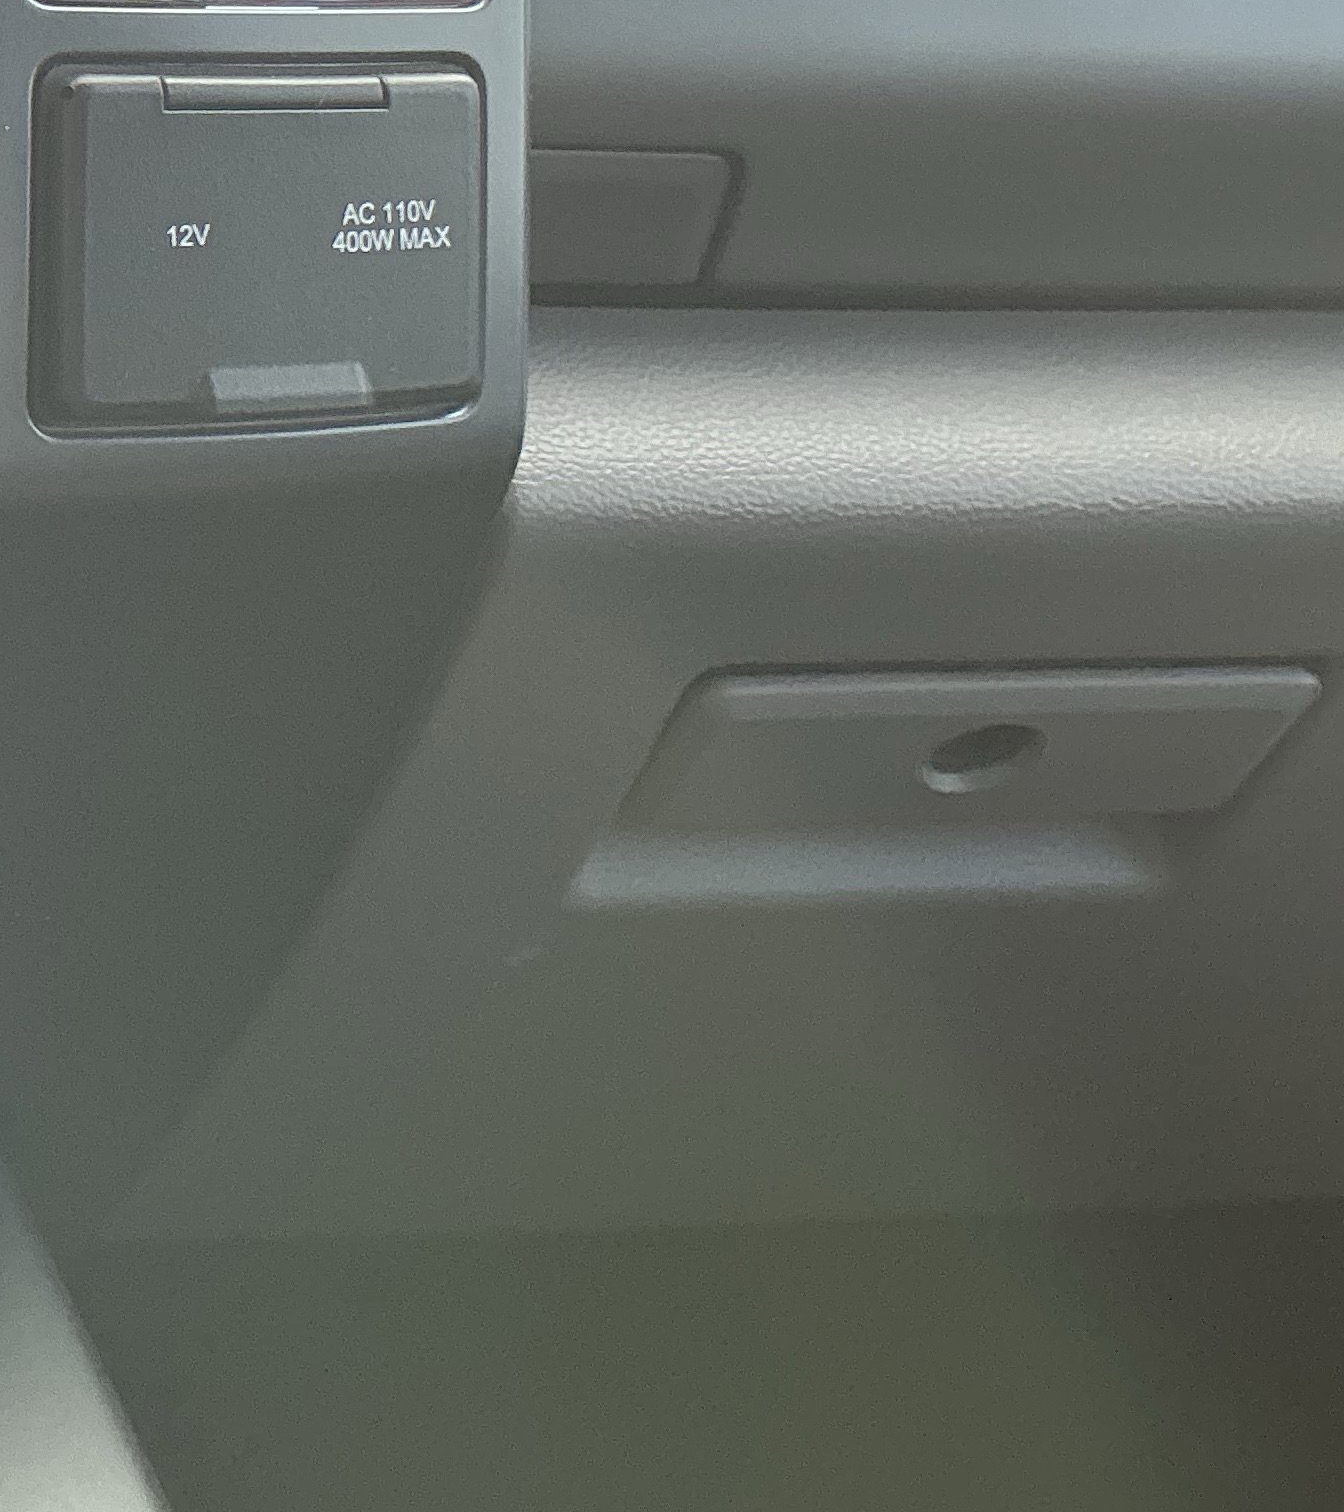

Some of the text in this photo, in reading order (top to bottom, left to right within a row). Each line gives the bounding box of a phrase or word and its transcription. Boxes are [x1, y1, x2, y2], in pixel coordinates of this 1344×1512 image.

[342, 200, 435, 226] AC 110V
[166, 224, 210, 248] 12V
[332, 227, 451, 253] 400W MAX
